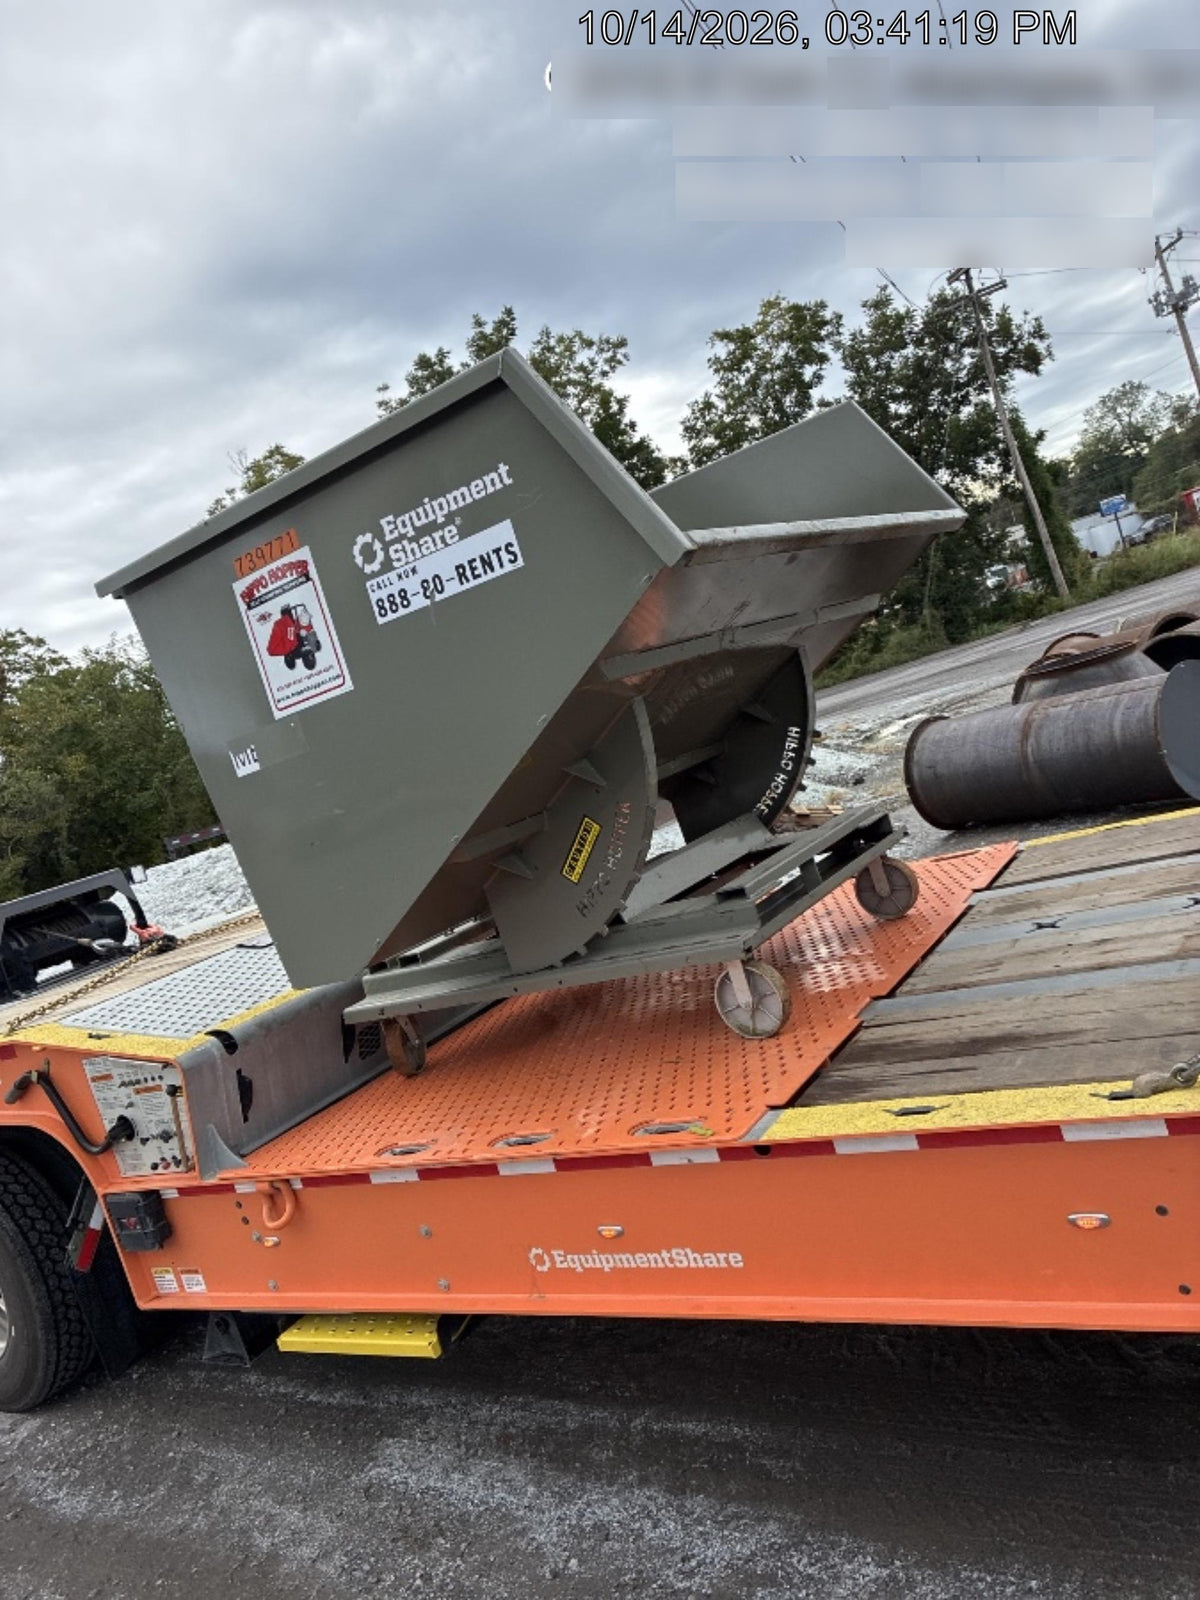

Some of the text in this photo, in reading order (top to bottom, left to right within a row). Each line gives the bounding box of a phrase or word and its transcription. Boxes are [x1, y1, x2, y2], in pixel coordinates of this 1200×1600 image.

[380, 462, 513, 539] Equipment
[388, 525, 460, 568] Share
[369, 565, 419, 593] CALL NOW
[374, 541, 520, 618] 888-80-RENTS
[753, 725, 800, 815] HIPPO HOPPE
[552, 1247, 744, 1272] EquipmentShare
